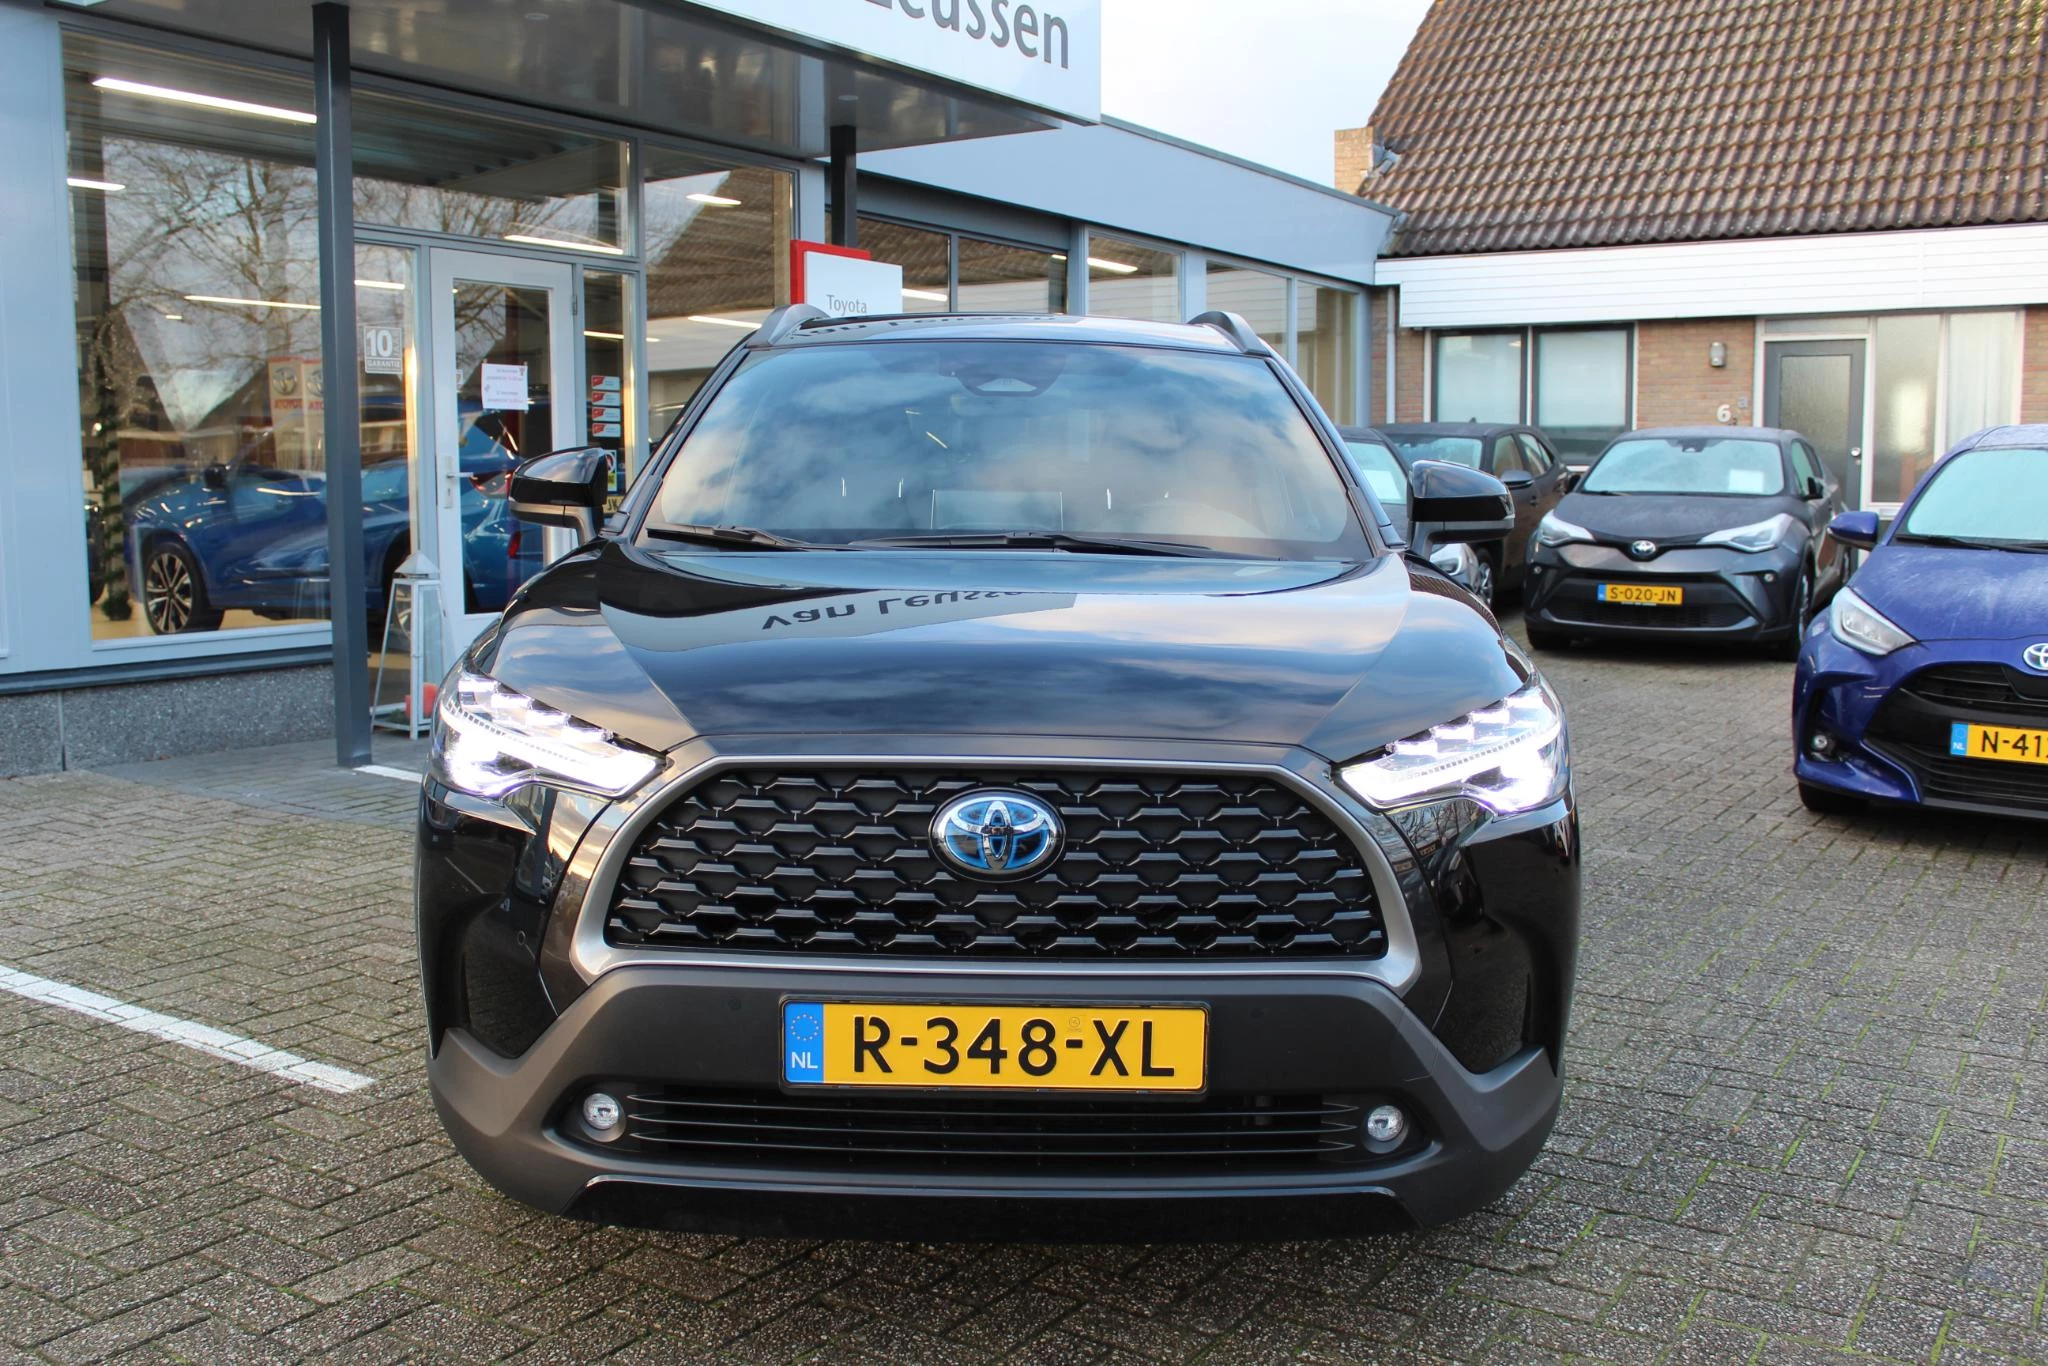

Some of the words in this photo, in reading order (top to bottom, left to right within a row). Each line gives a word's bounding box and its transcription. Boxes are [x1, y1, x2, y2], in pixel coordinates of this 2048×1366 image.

[862, 0, 1069, 69] ussen
[826, 294, 867, 315] Toyota
[366, 329, 393, 357] 10
[366, 359, 401, 368] GARANTIE
[1716, 403, 1731, 422] 6
[1610, 587, 1677, 602] S-020-JN
[1981, 730, 2048, 759] N-41
[853, 1016, 1175, 1077] R-348-XL
[791, 1051, 818, 1069] NL
